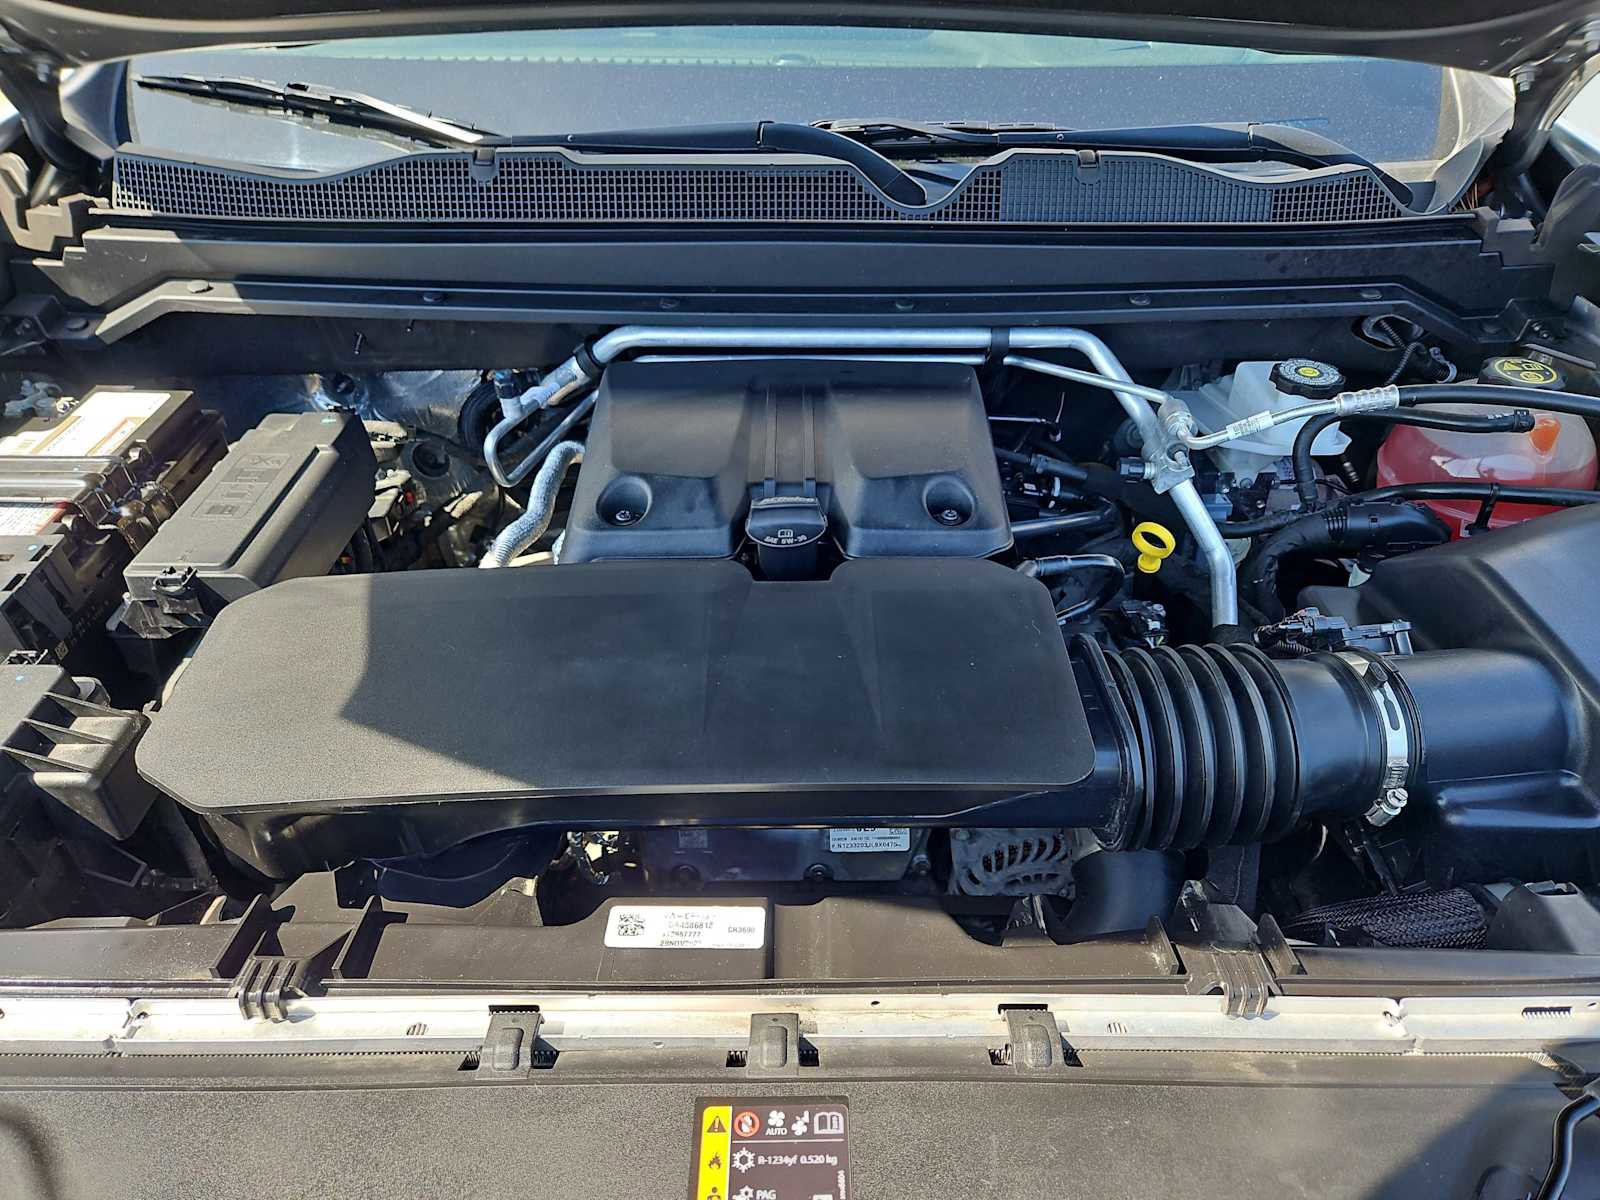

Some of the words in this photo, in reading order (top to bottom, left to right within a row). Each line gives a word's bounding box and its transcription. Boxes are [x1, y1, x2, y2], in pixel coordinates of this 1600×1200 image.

[764, 536, 778, 544] SAE
[765, 1127, 788, 1136] AUTO
[757, 1154, 797, 1167] R-1234yf
[799, 1154, 825, 1165] 0.520
[826, 1154, 838, 1167] kg
[755, 1189, 777, 1200] PAG
